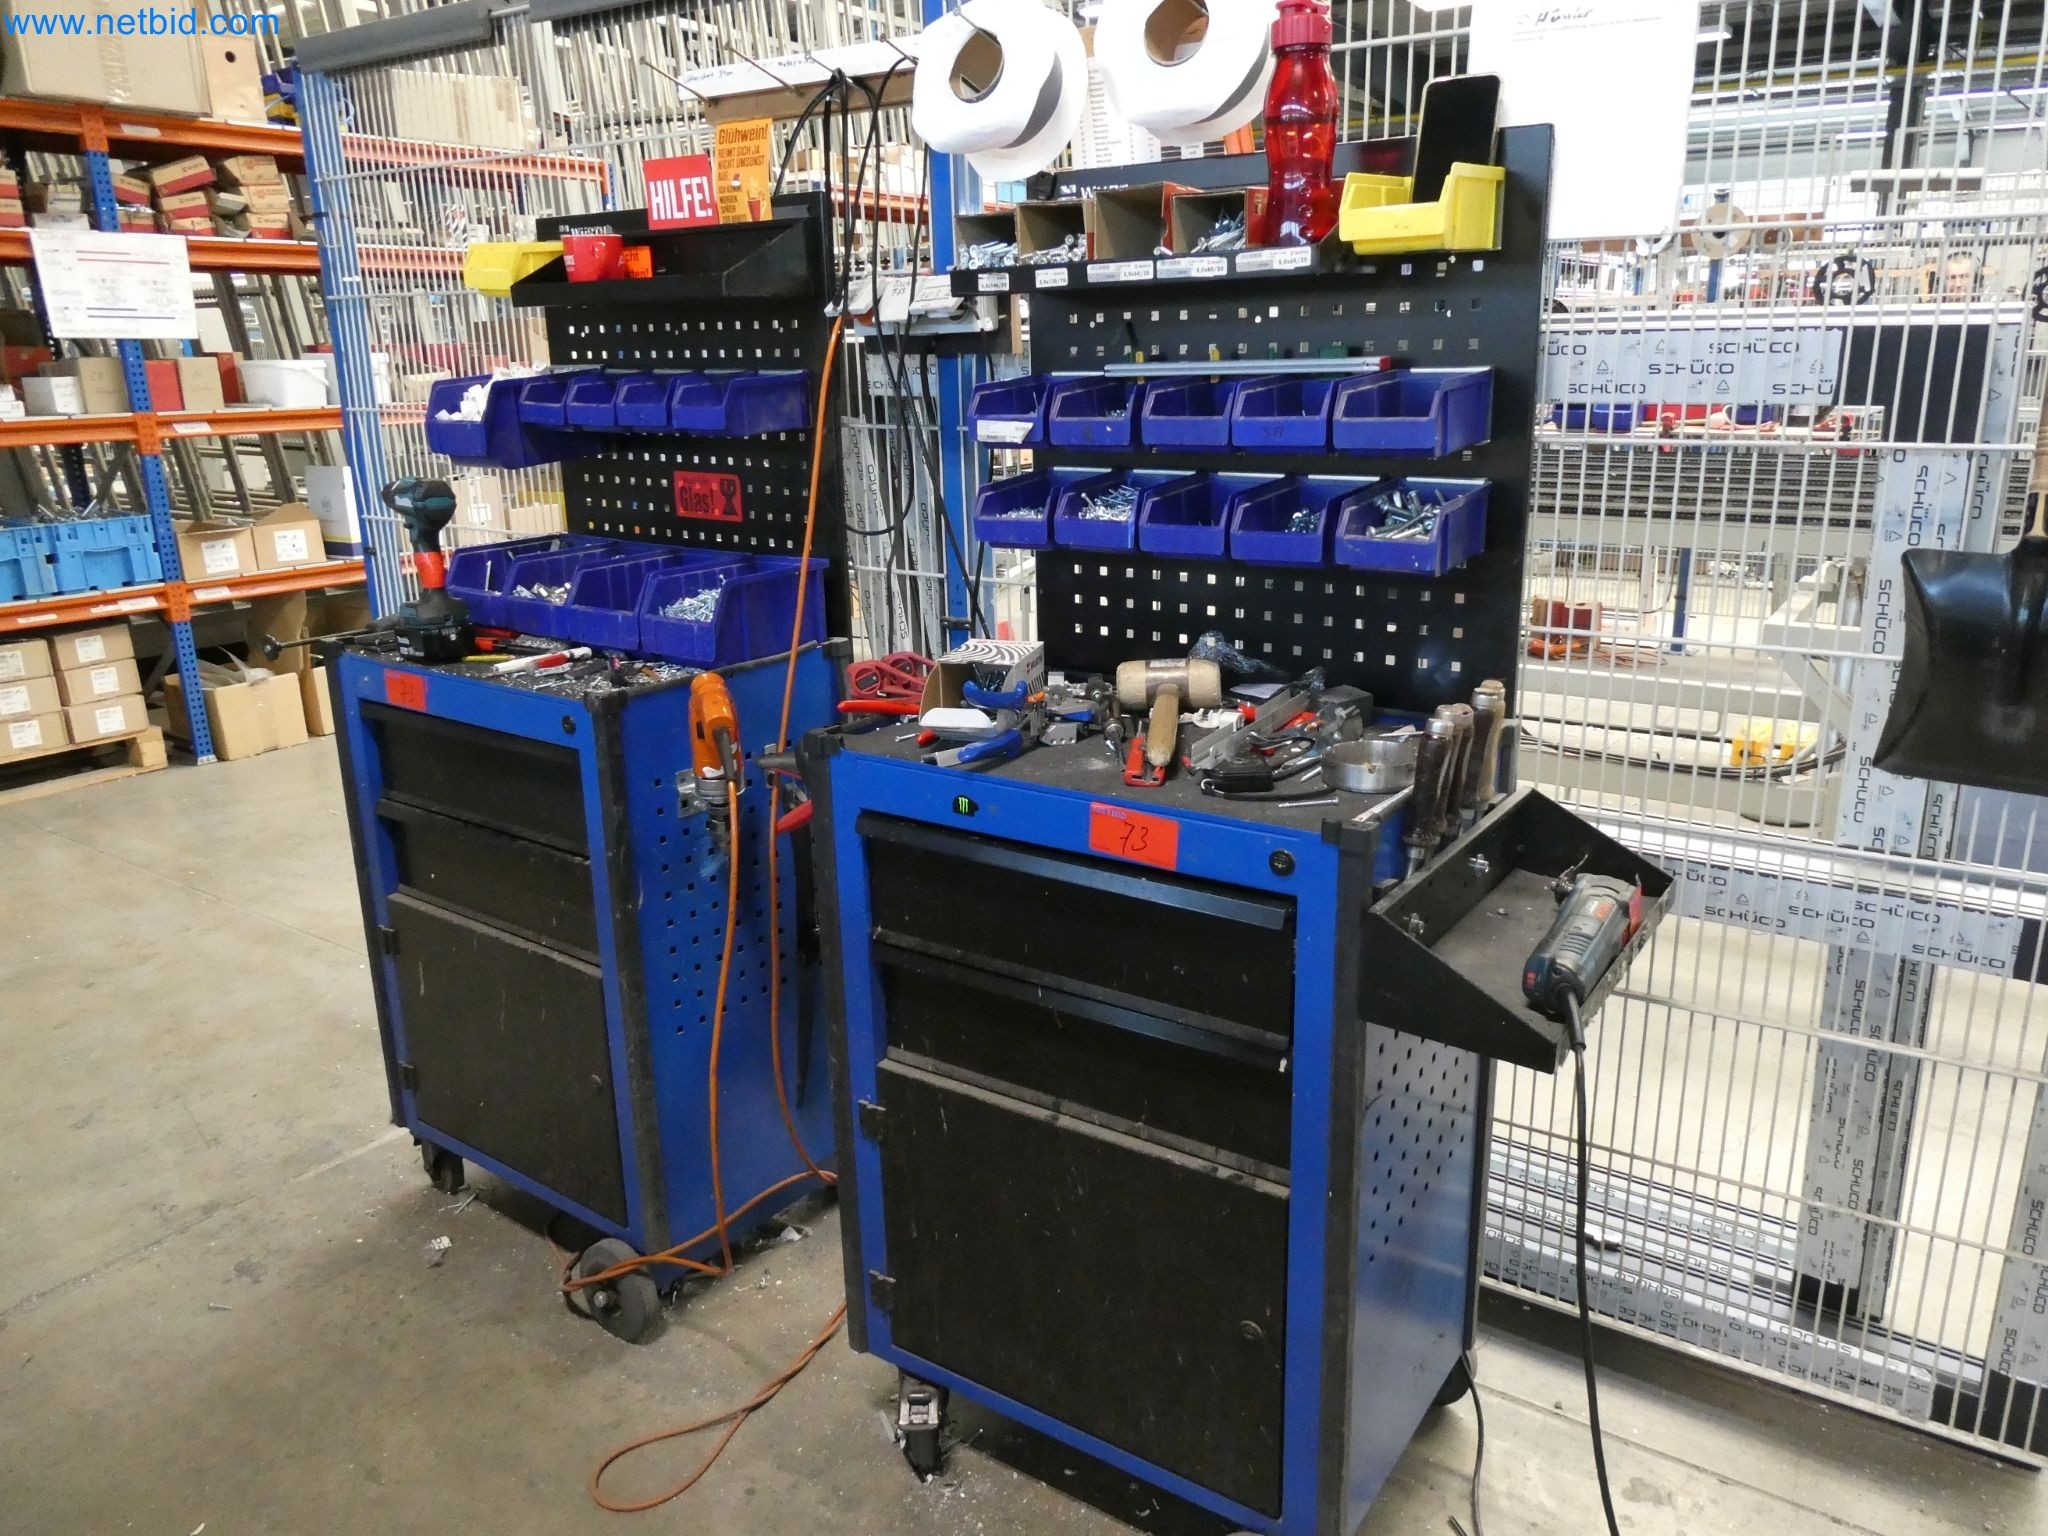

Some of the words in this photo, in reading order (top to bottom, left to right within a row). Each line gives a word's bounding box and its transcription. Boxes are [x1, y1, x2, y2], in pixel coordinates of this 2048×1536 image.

[719, 123, 769, 145] Glühwein!
[718, 159, 735, 170] NICHT
[736, 155, 765, 168] UMSONST
[649, 175, 713, 221] HILFE!
[1907, 465, 1930, 547] SCHÜCO
[1872, 578, 1893, 655] SCHÜCO
[1119, 820, 1149, 855] 73
